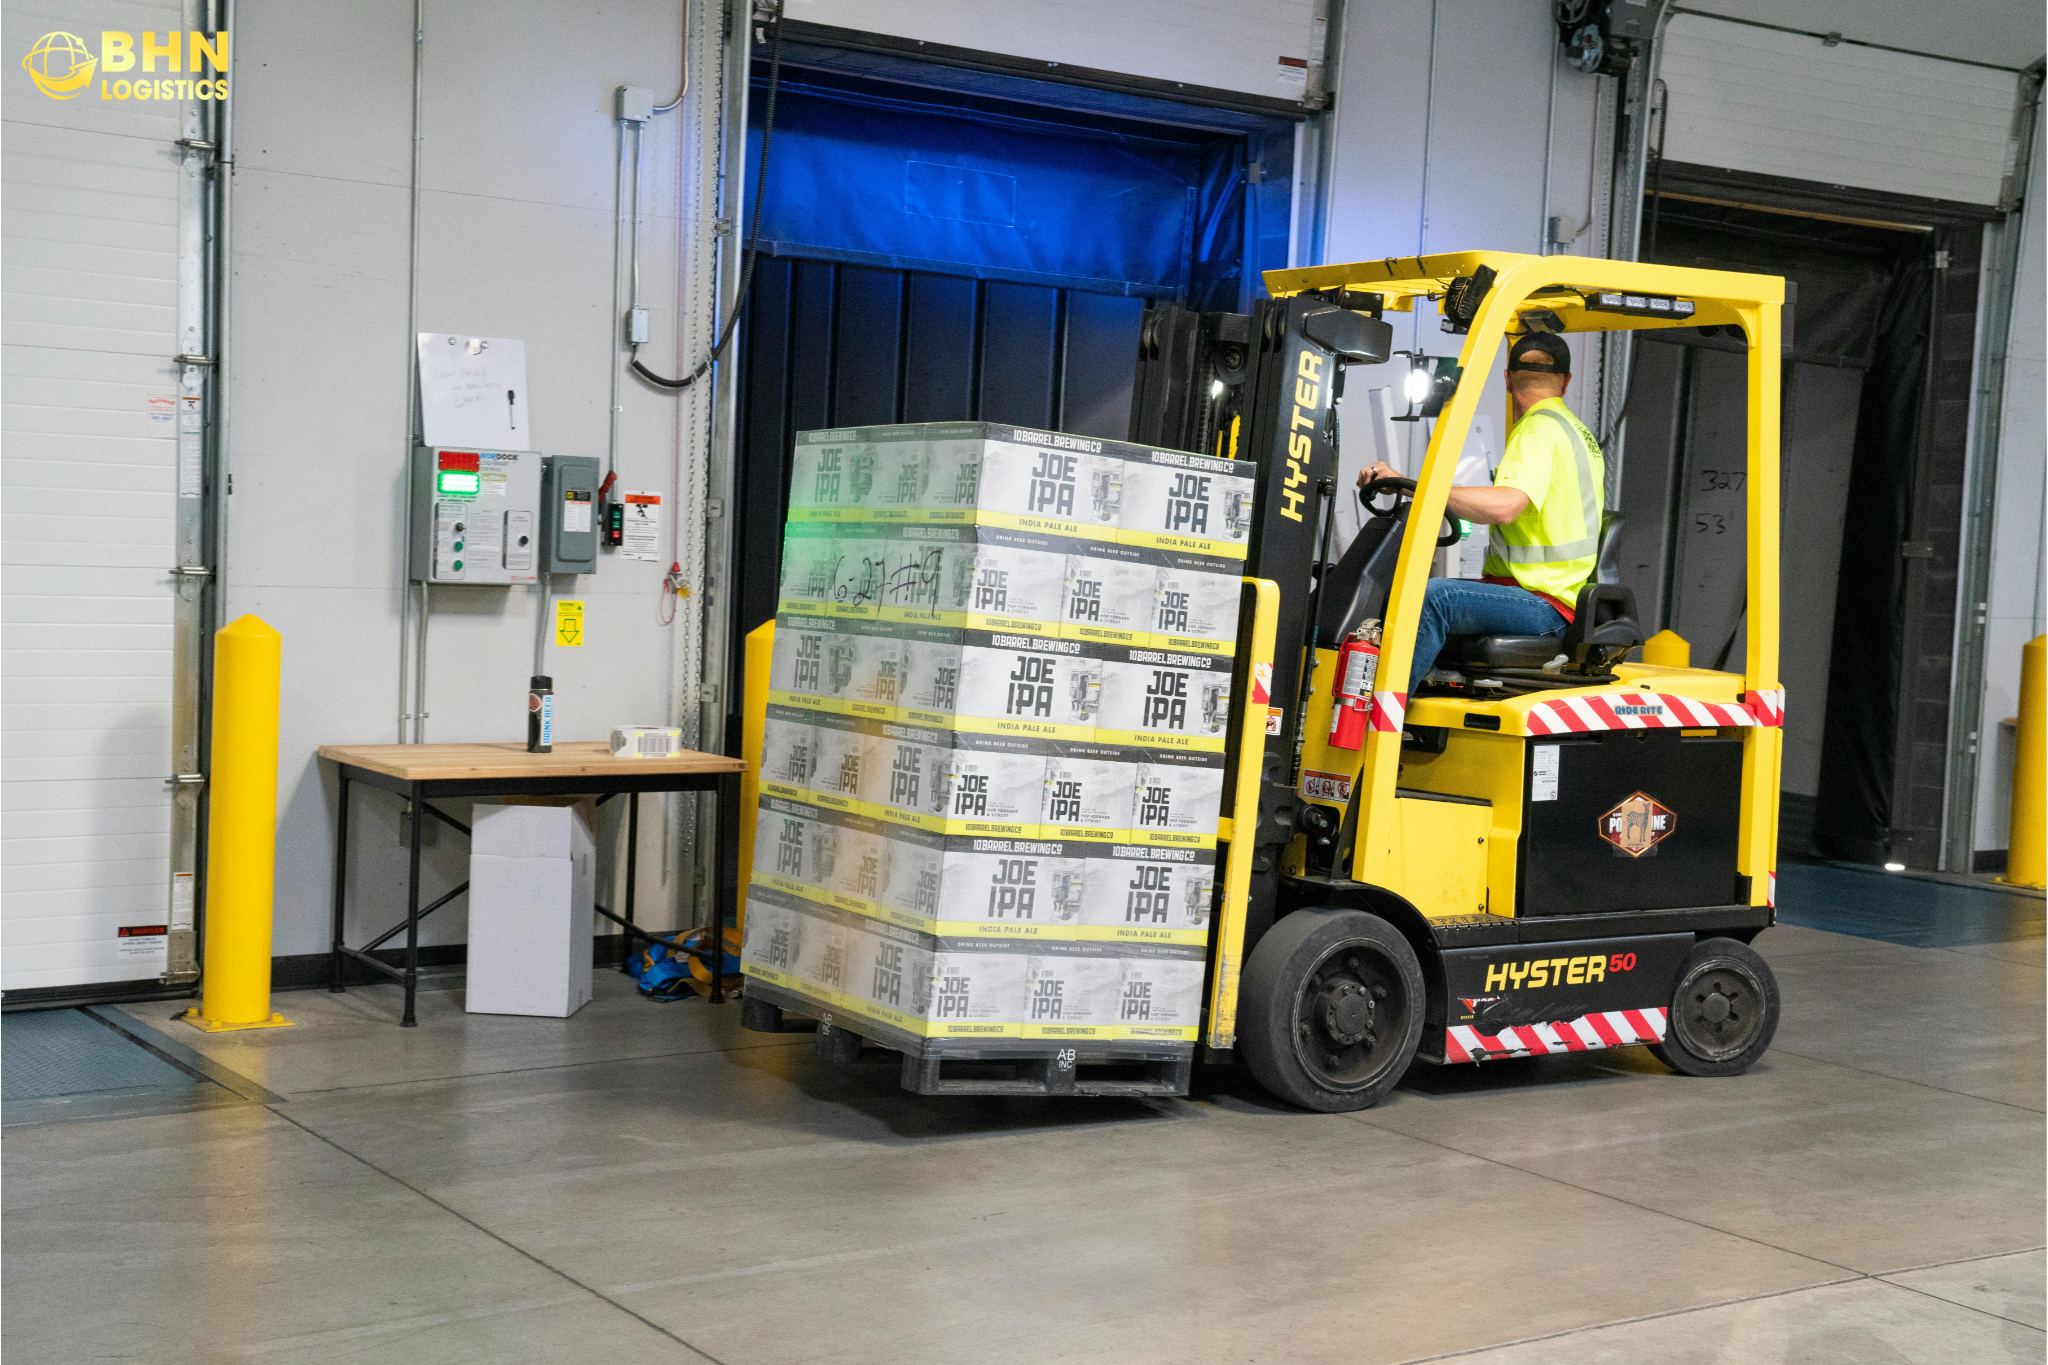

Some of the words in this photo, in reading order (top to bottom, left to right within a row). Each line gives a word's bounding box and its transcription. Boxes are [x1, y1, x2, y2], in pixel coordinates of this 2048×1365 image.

[1280, 350, 1323, 523] HYSTER
[818, 448, 842, 472] JOE
[1032, 452, 1078, 482] JOE
[899, 464, 918, 480] JOE
[957, 464, 978, 481] JOE
[1702, 470, 1748, 491] 327
[814, 474, 840, 502] IPA
[897, 482, 917, 503] IPA
[954, 482, 976, 504] IPA
[1028, 479, 1076, 516] IPA
[1168, 473, 1212, 502] JOE
[1019, 518, 1042, 529] INDIA
[1044, 521, 1062, 531] PALE
[1064, 524, 1077, 533] ALE
[1164, 498, 1208, 534] IPA
[996, 534, 1012, 542] DRINK
[1156, 537, 1178, 546] INDIA
[1180, 540, 1196, 548] PALE
[1198, 542, 1211, 550] ALE
[1120, 550, 1140, 558] OUTSIDE
[977, 569, 1008, 588] JOE
[1072, 579, 1102, 598] JOE
[975, 586, 1007, 611] IPA
[1070, 597, 1100, 622] IPA
[1161, 591, 1190, 610] JOE
[1158, 608, 1187, 632] IPA
[797, 634, 821, 659] JOE
[794, 659, 819, 690] IPA
[878, 661, 897, 678] JOE
[935, 668, 956, 686] JOE
[1010, 656, 1056, 684] JOE
[875, 678, 895, 700] IPA
[1147, 670, 1189, 697] JOE
[932, 686, 954, 710] IPA
[1006, 682, 1053, 717] IPA
[1143, 696, 1186, 729] IPA
[1615, 706, 1638, 715] RIDE
[1640, 706, 1662, 714] RITE
[998, 722, 1019, 731] INDIA
[1022, 724, 1040, 732] PALE
[1042, 726, 1056, 734] ALE
[1158, 736, 1174, 744] PALE
[790, 745, 807, 762] JOE
[841, 754, 859, 772] JOE
[893, 745, 922, 773] JOE
[788, 761, 806, 783] IPA
[839, 772, 858, 794] IPA
[890, 771, 920, 806] IPA
[958, 775, 988, 793] JOE
[1052, 781, 1082, 799] JOE
[955, 793, 987, 816] IPA
[1142, 787, 1171, 804] JOE
[1050, 799, 1080, 822] IPA
[1140, 804, 1169, 826] IPA
[780, 819, 804, 846] JOE
[777, 843, 802, 877] IPA
[992, 859, 1038, 885] JOE
[1130, 866, 1172, 891] JOE
[988, 886, 1036, 918] IPA
[1126, 892, 1169, 923] IPA
[876, 942, 903, 972] JOE
[1485, 955, 1606, 992] HYSTER
[1609, 953, 1636, 972] 50
[872, 968, 902, 1005] IPA
[940, 977, 970, 994] JOE
[1034, 980, 1064, 997] JOE
[1124, 982, 1152, 998] JOE
[936, 996, 968, 1017] IPA
[1031, 998, 1062, 1020] IPA
[1120, 999, 1150, 1021] IPA
[1058, 1060, 1073, 1068] INC
